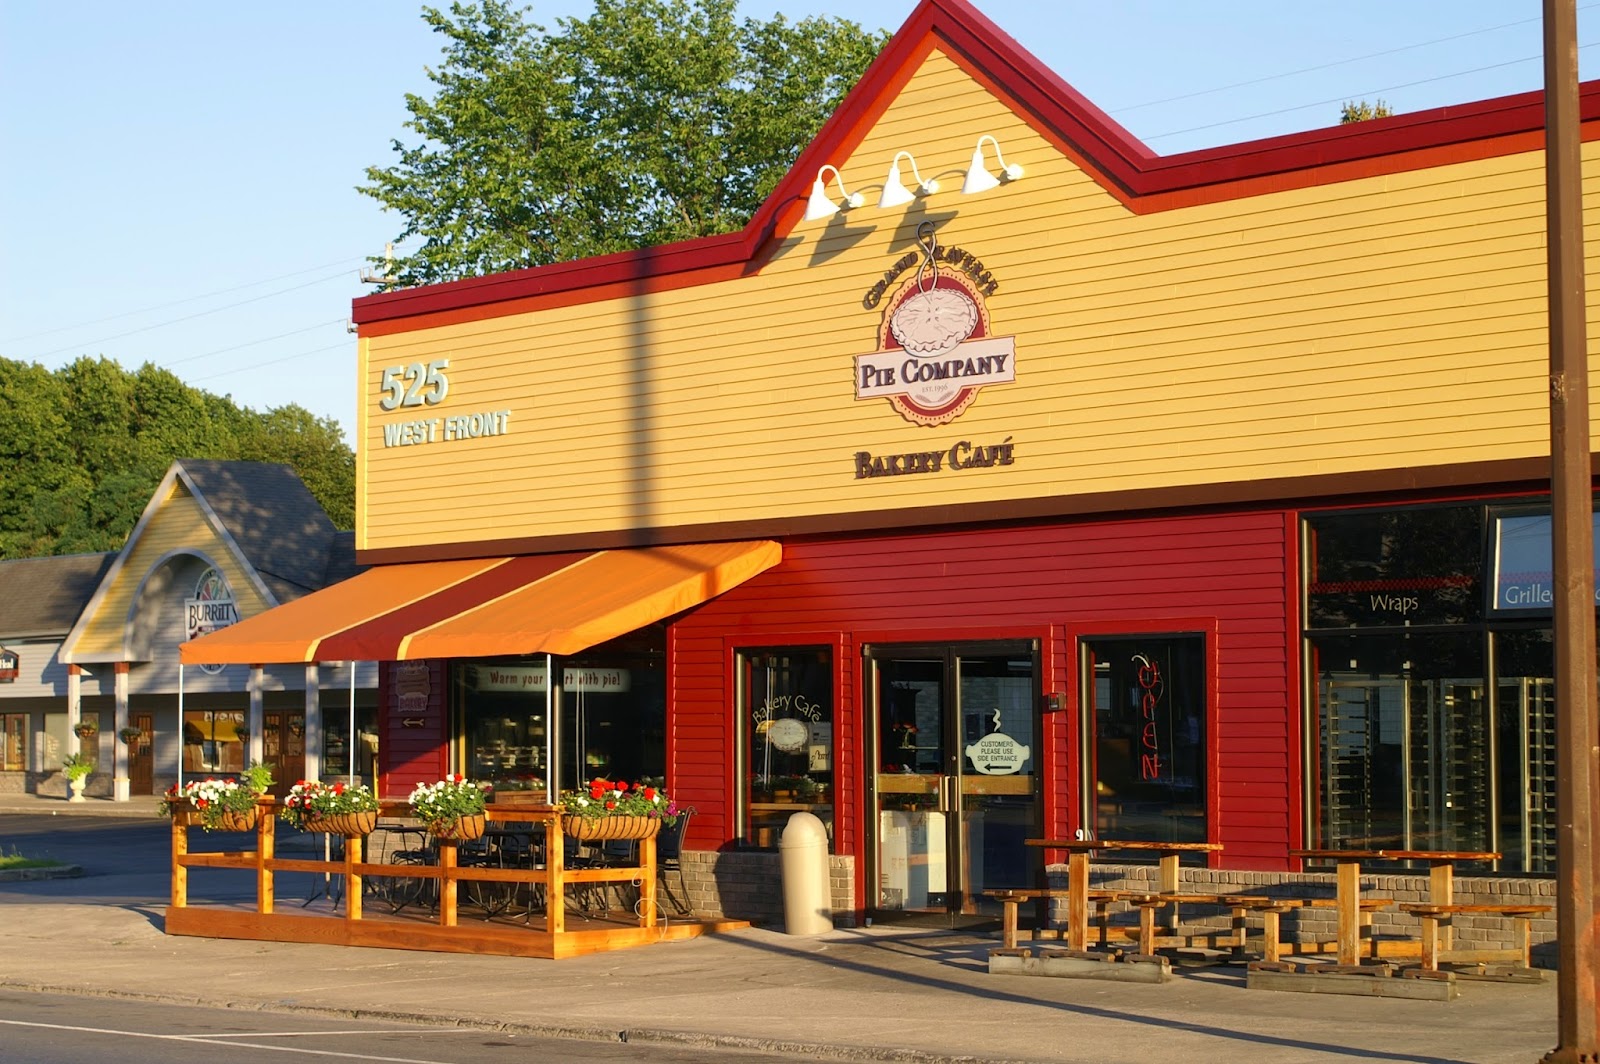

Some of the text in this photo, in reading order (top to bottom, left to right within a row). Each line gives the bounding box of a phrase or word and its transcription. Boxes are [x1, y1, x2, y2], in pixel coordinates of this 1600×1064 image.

[862, 251, 919, 310] GRAND
[380, 358, 450, 411] 525
[860, 353, 1010, 389] PIE COMPANY
[383, 409, 511, 448] WEST FRONT
[853, 435, 1015, 480] BAKERY CAFÉ
[1370, 594, 1419, 616] Wraps
[1505, 583, 1553, 604] Grille
[490, 670, 518, 684] Warm
[522, 674, 544, 688] your
[579, 671, 599, 685] with
[602, 671, 620, 688] pie!
[752, 694, 822, 726] Bakery Café
[1138, 661, 1159, 781] OPEN
[980, 740, 1014, 748] CUSTOMERS
[980, 747, 1014, 755] PLEASE USE
